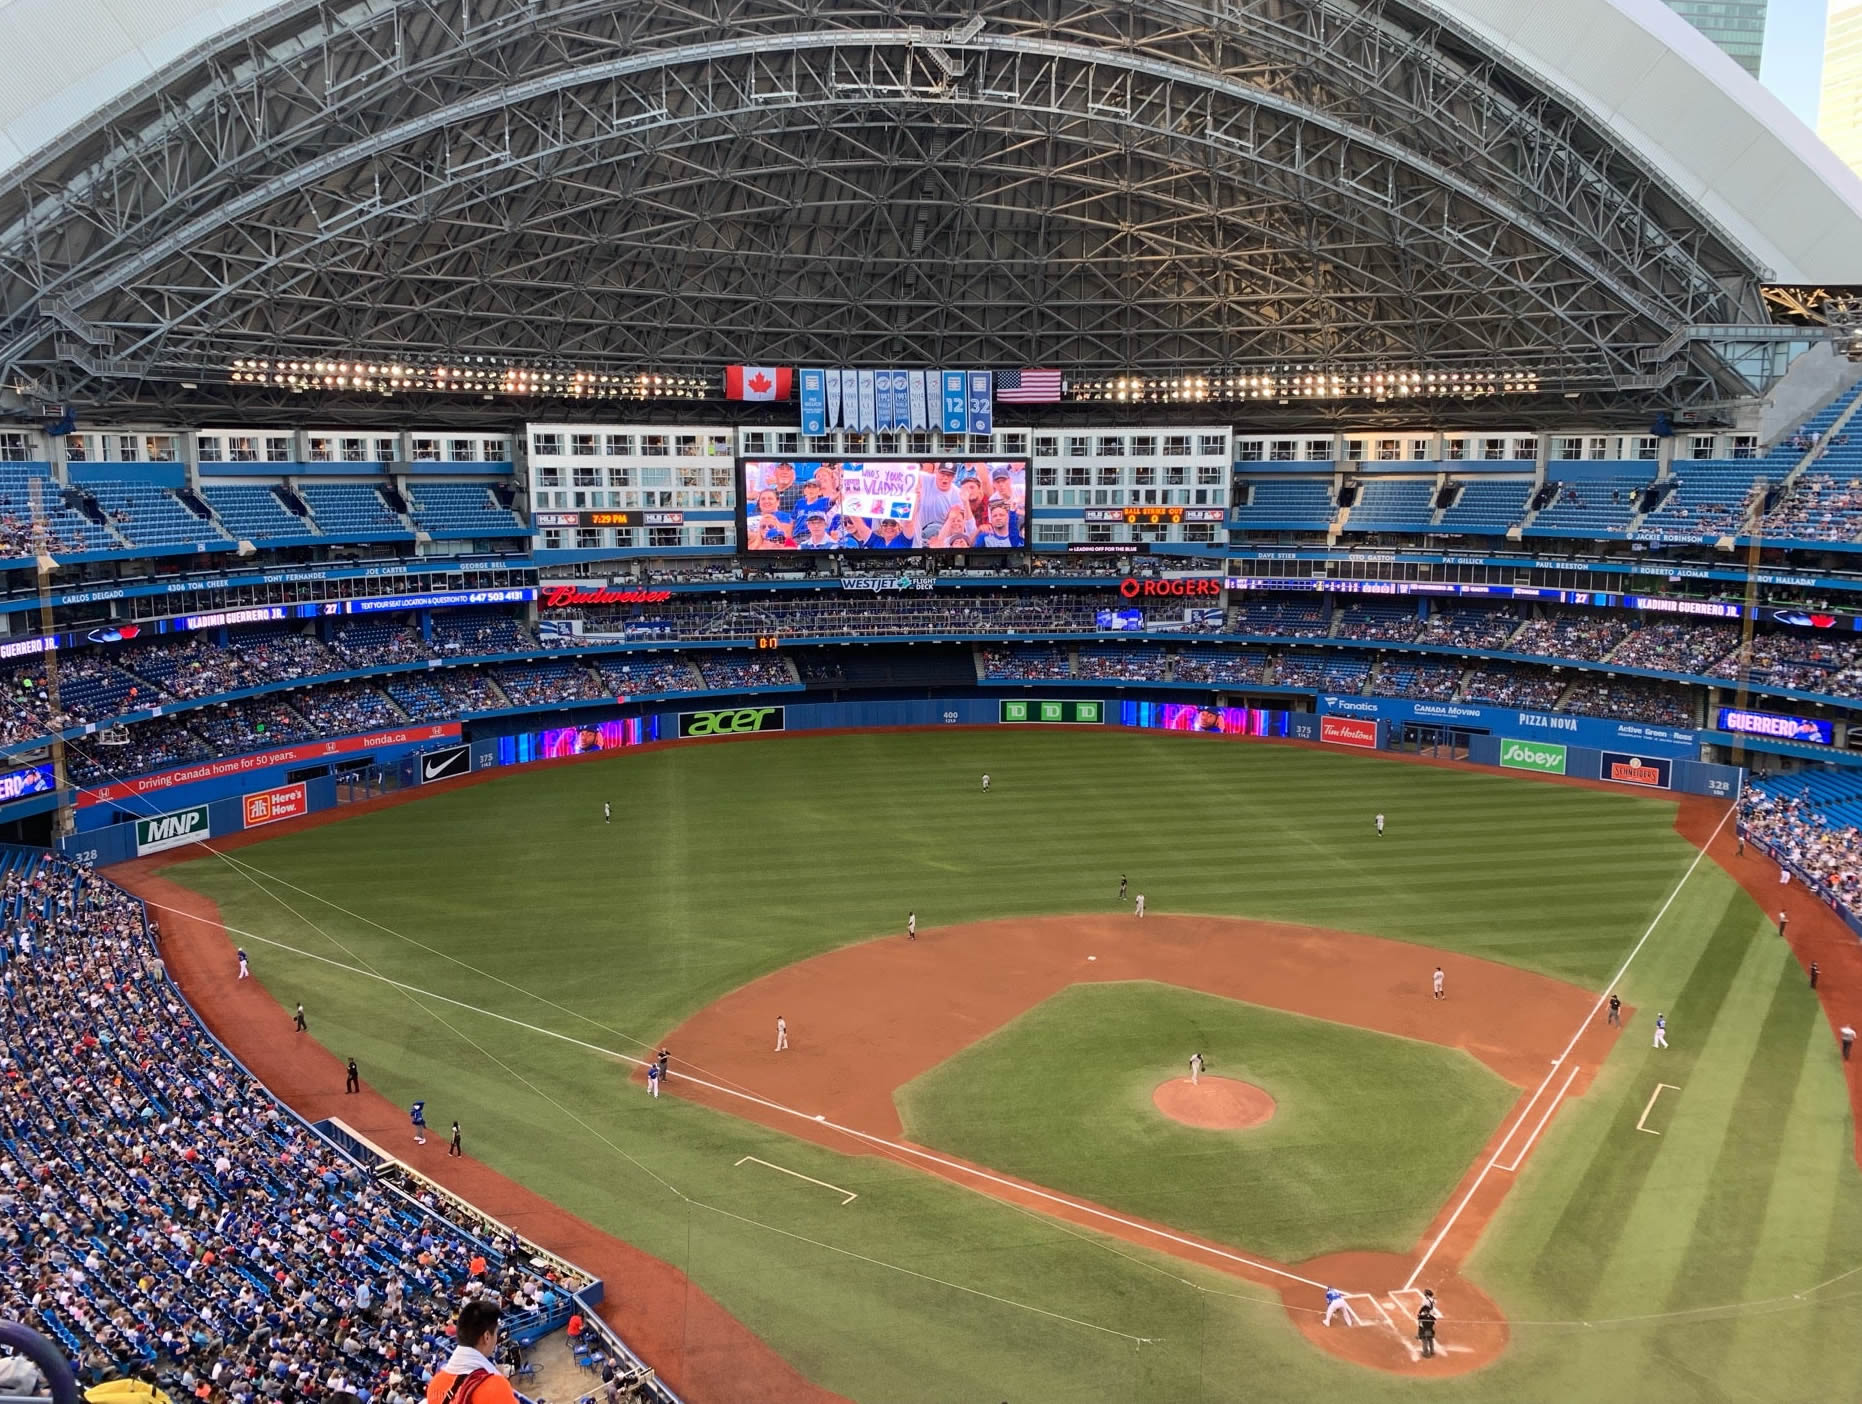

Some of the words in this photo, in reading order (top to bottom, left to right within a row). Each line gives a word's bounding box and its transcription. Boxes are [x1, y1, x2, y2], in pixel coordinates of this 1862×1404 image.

[945, 398, 964, 413] 12
[970, 398, 990, 414] 32
[592, 514, 611, 524] 7:29
[612, 514, 628, 524] PM
[1128, 515, 1136, 523] 0
[1151, 515, 1159, 523] 0
[1172, 515, 1180, 523] 0
[1663, 535, 1703, 543] ROBINSON
[366, 568, 379, 576] JOE
[382, 566, 408, 574] CARTER
[1536, 561, 1553, 569] PAUL
[1556, 562, 1589, 570] BEESTON
[263, 575, 283, 583] TONY
[286, 572, 327, 581] FERNANDEZ
[1640, 568, 1674, 576] ROBERTO
[1677, 569, 1709, 578] ALOMAR
[168, 583, 185, 592] 4306
[188, 582, 204, 590] TOM
[206, 580, 229, 589] CHEEK
[841, 578, 897, 592] WESTJET
[1758, 575, 1773, 583] ROY
[1776, 576, 1816, 586] HALLADAY
[1144, 579, 1220, 596] ROGERS
[62, 593, 90, 604] CARLOS
[92, 590, 124, 602] DELGADO
[402, 599, 428, 607] LOCATION
[432, 596, 460, 605] QUESTION
[469, 593, 486, 603] 647
[488, 592, 504, 601] 503
[541, 585, 672, 607] Budweiser
[1575, 593, 1587, 603] 27
[324, 604, 337, 614] 27
[1637, 598, 1677, 612] VLADIMIR
[1678, 601, 1724, 616] GUERRERO
[1726, 605, 1739, 617] JR.
[188, 613, 225, 630] VLADIMIR
[226, 609, 269, 624] GUERRERO
[271, 608, 285, 619] JR.
[0, 639, 43, 659] GUERRERO
[44, 637, 59, 650] JR.
[1009, 705, 1025, 717] TD
[1043, 705, 1060, 718] TD
[1079, 706, 1095, 718] TD
[1338, 700, 1378, 712] Fanatics
[688, 708, 776, 735] acer
[1519, 713, 1548, 727] PIZZA
[1550, 717, 1577, 731] NOVA
[1727, 712, 1798, 737] GUERRERO
[1296, 725, 1311, 734] 375
[1324, 724, 1339, 737] Tim
[1339, 726, 1373, 741] Hortons
[1618, 725, 1642, 735] Active
[1645, 728, 1667, 738] Green
[363, 734, 406, 748] honda.ca
[480, 752, 493, 763] 375
[1503, 744, 1563, 768] Sobeys
[139, 774, 172, 791] Driving
[174, 767, 210, 782] Canada
[213, 760, 239, 774] home
[241, 757, 253, 768] for
[256, 755, 268, 765] 50
[269, 750, 297, 766] years.
[1708, 780, 1729, 790] 328
[271, 790, 301, 804] Here's
[272, 803, 297, 816] How.
[147, 811, 200, 843] MNP
[75, 849, 98, 863] 328
